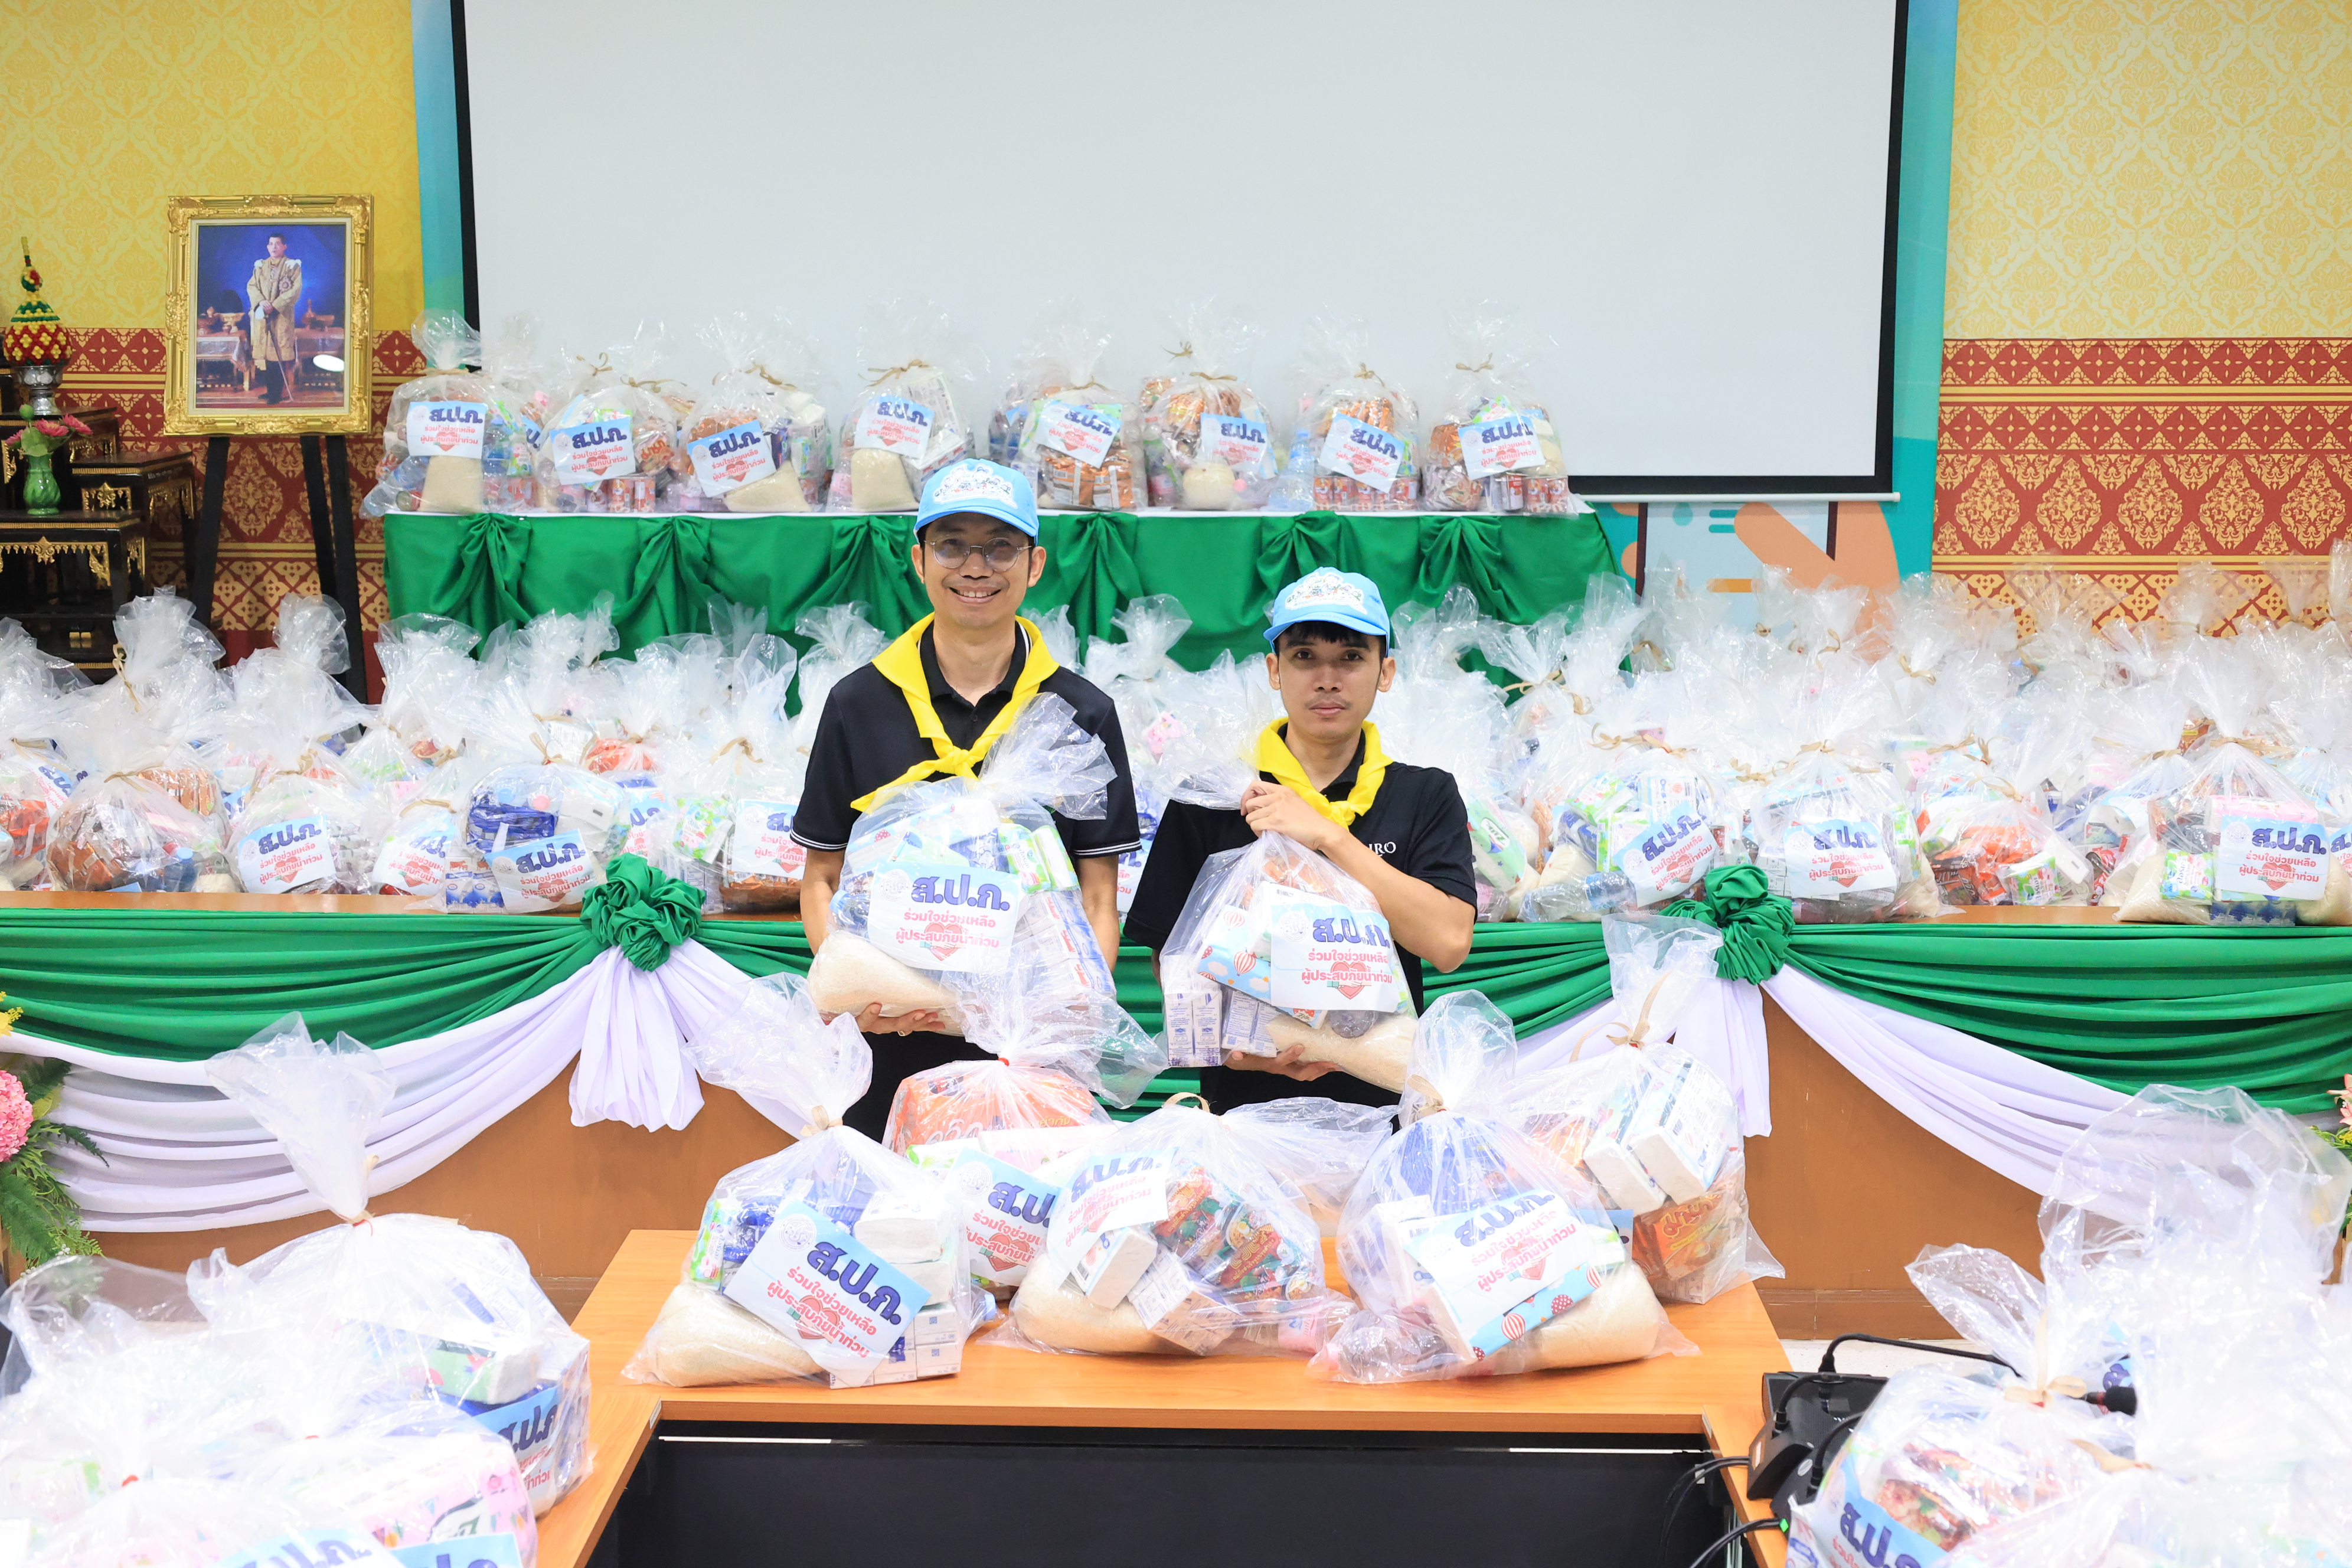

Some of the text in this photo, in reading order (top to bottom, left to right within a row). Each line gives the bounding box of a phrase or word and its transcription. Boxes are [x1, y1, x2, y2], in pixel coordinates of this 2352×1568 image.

[429, 406, 483, 423] ส.ป.ก.
[572, 426, 627, 449] ส.ป.ก.
[709, 432, 761, 458] ส.ป.ก.
[1350, 429, 1398, 460] ส.ป.ก.
[1482, 422, 1533, 443] ส.ป.ก.
[259, 823, 322, 854] ส.ป.ก.
[1642, 815, 1702, 861] ส.ป.ก.
[1814, 826, 1878, 851] ส.ป.ก.
[2252, 827, 2327, 855] ส.ป.ก.
[259, 842, 316, 868] ร่วมใจช่วยเหลือ
[516, 842, 586, 874] ส.ป.ก.
[1651, 835, 1703, 876] ร่วมใจช่วยเหลือ
[2246, 850, 2317, 867] ร่วมใจช่วยเหลือ
[259, 854, 323, 885] ผู้ประสบภัยน้ำท่วม
[520, 865, 583, 885] ร่วมใจช่วยเหลือ
[1809, 862, 1884, 881] ผู้ประสบภัยน้ำท่วม
[2239, 864, 2320, 883] ผู้ประสบภัยน้ำท่วม
[521, 874, 590, 899] ผู้ประสบภัยน้ำท่วม
[911, 874, 1011, 911] ส.ป.ก.
[904, 908, 996, 928] ร่วมใจช่วยเหลือ
[896, 927, 999, 948] ผู้ประสบภัยน้ำท่วม
[1312, 916, 1390, 949] ส.ป.ก.
[1308, 948, 1389, 963] ร่วมใจช่วยเหลือ
[1301, 966, 1392, 984] ผู้ประสบภัยน้ำท่วม
[1071, 1156, 1163, 1203] ส.ป.ก.
[807, 1241, 901, 1325] ส.ป.ก.
[787, 1266, 877, 1336] ร่วมใจช่วยเหลือ
[767, 1280, 870, 1358] ผู้ประสบภัยน้ำท่วม
